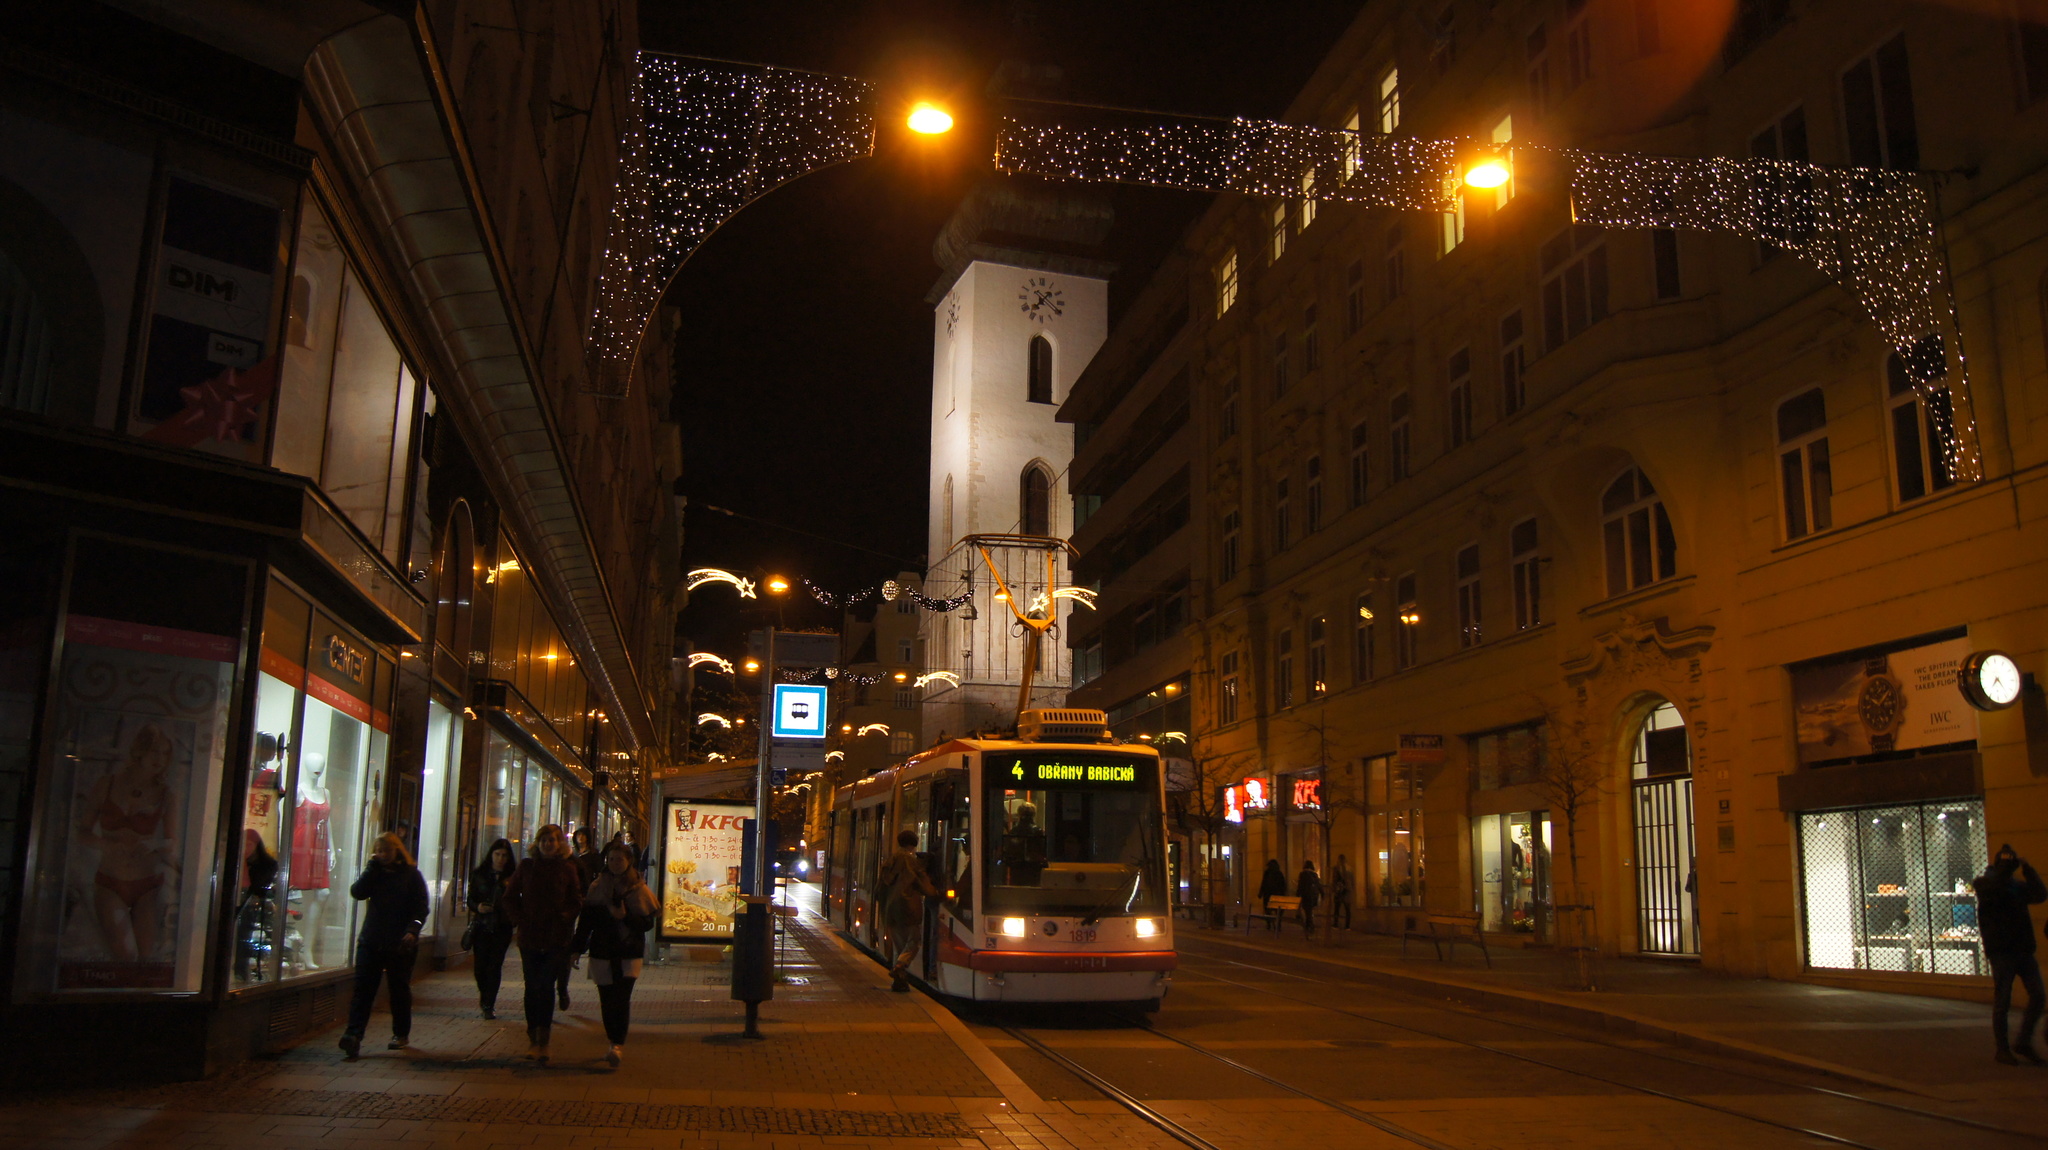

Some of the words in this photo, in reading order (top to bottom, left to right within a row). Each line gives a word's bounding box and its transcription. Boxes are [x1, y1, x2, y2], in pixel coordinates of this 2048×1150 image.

[168, 264, 234, 301] DIM
[1918, 674, 1931, 682] THE
[1932, 669, 1956, 680] DREAM
[1915, 681, 1935, 691] TAKES
[1930, 710, 1952, 725] IWC
[1011, 760, 1024, 780] 4
[1038, 762, 1083, 780] OBŘANY
[1088, 764, 1134, 782] BABICKÁ
[1293, 779, 1321, 805] KFC
[702, 835, 718, 843] 7:30
[702, 843, 718, 851] 7:30
[705, 852, 720, 860] 7:30
[702, 922, 715, 932] 20
[1069, 930, 1097, 942] 1819
